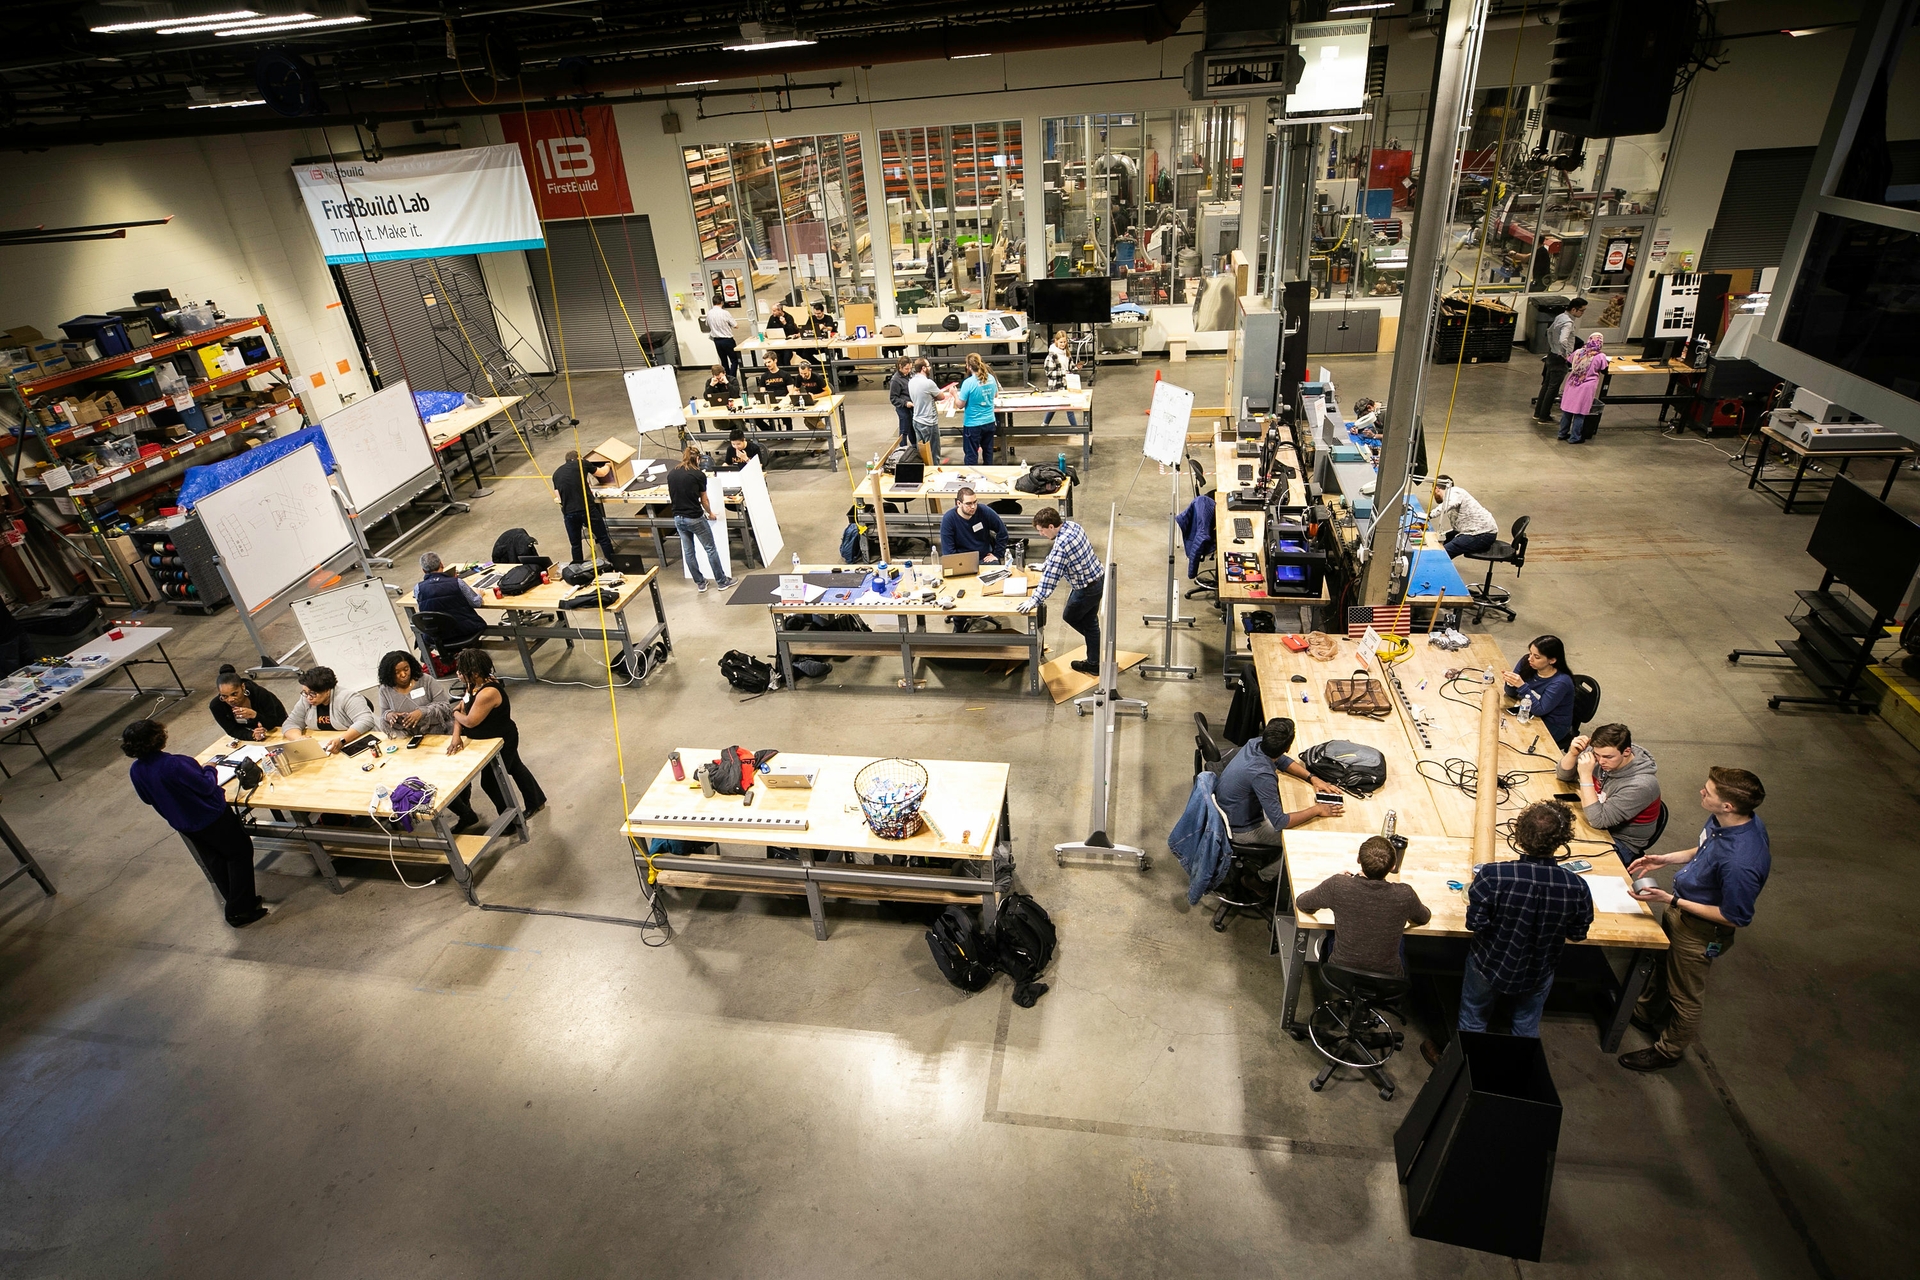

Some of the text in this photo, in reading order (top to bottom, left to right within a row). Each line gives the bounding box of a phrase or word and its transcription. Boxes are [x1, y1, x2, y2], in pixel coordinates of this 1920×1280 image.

[324, 166, 364, 179] firsbuild
[321, 192, 430, 220] FirstBuild Lab
[363, 226, 378, 241] it.
[377, 224, 407, 240] Make
[409, 222, 422, 238] it.
